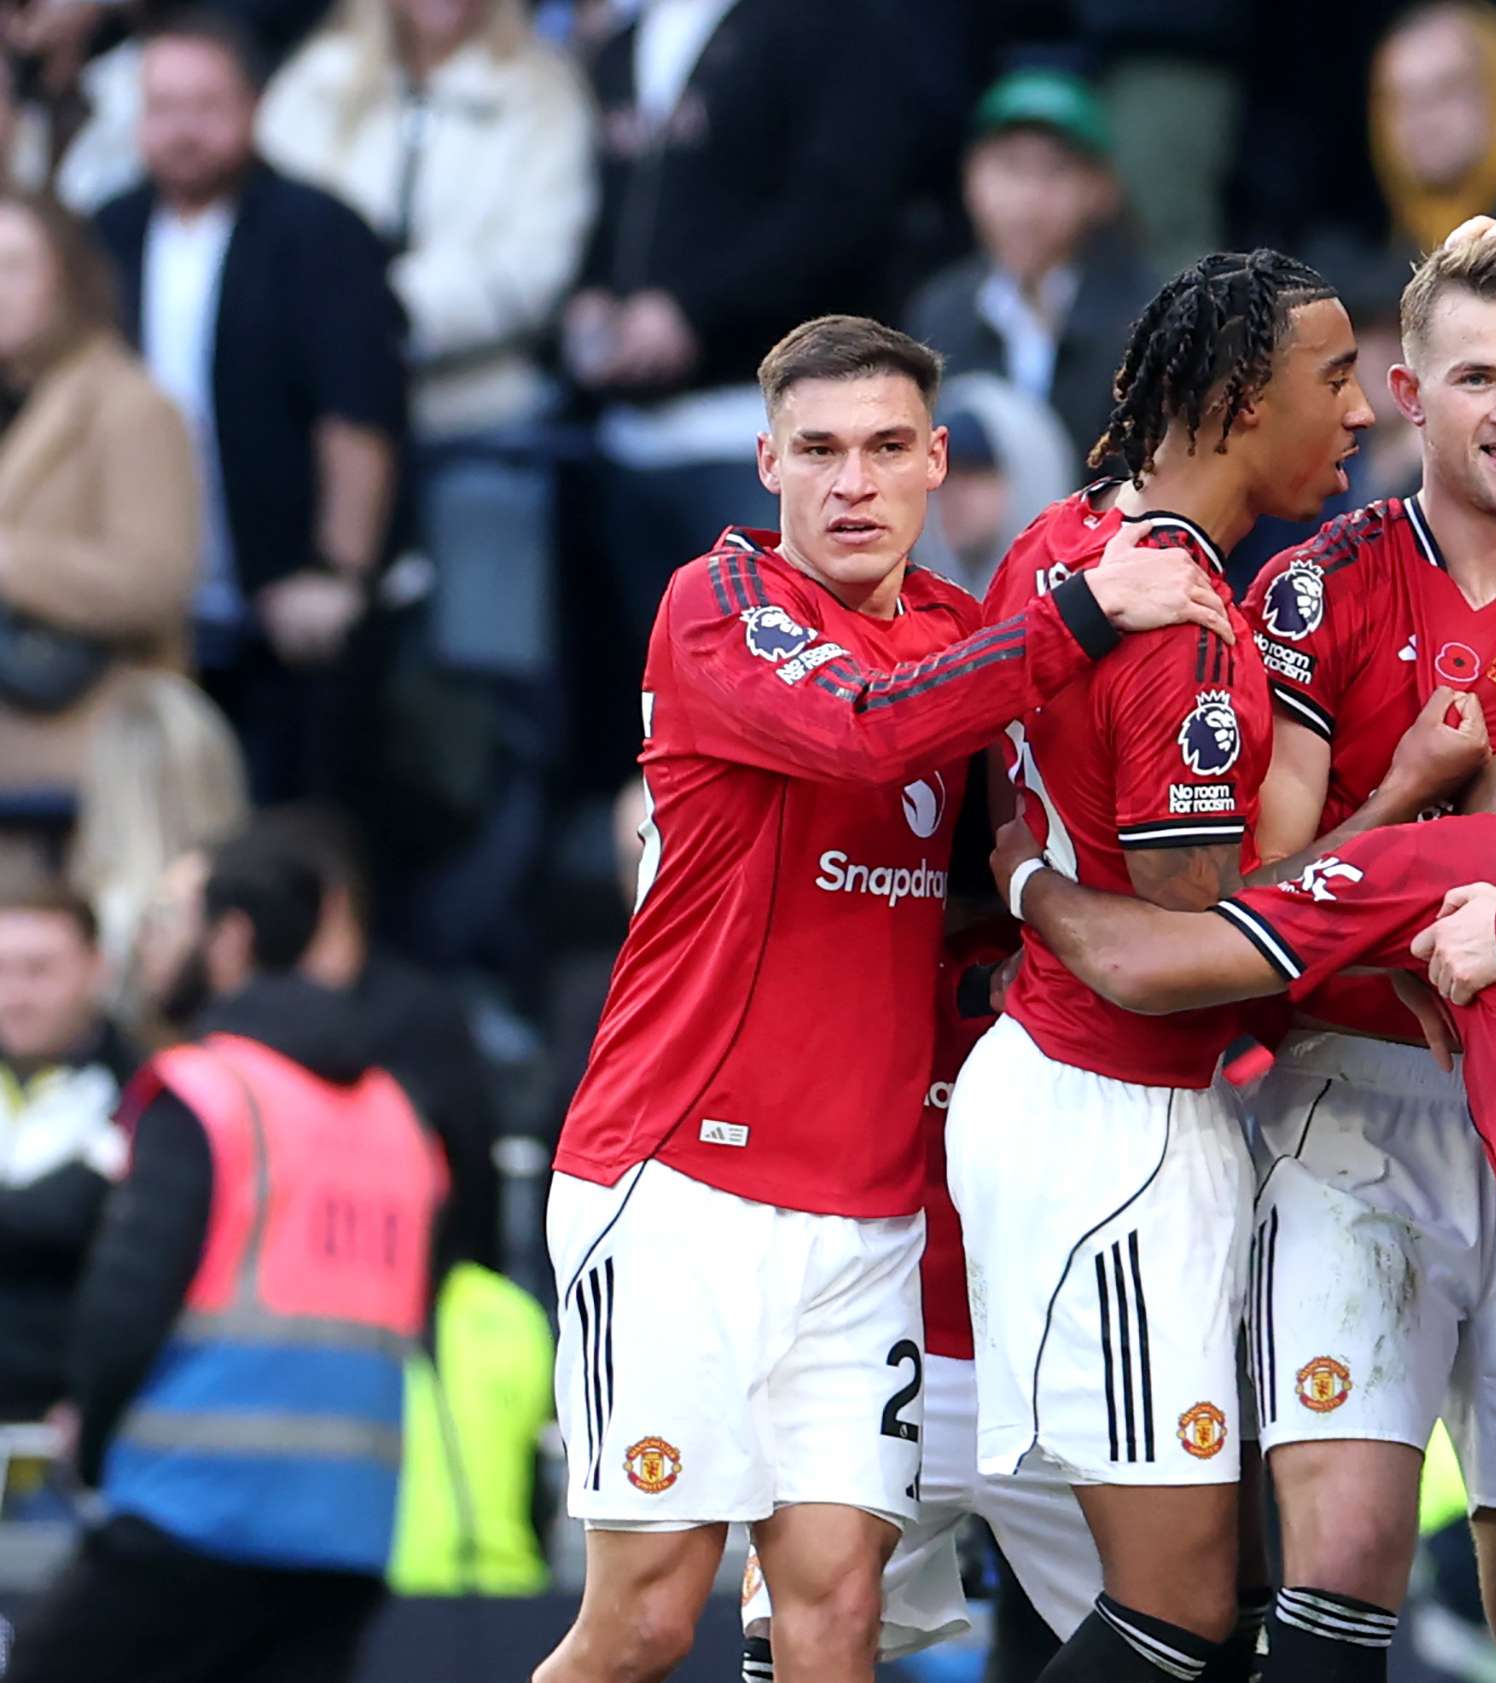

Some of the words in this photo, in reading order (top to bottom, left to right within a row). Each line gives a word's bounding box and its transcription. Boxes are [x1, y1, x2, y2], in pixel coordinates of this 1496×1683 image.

[1169, 784, 1193, 800] No
[1194, 785, 1230, 799] room
[1193, 798, 1235, 813] racism
[880, 1338, 922, 1443] 2
